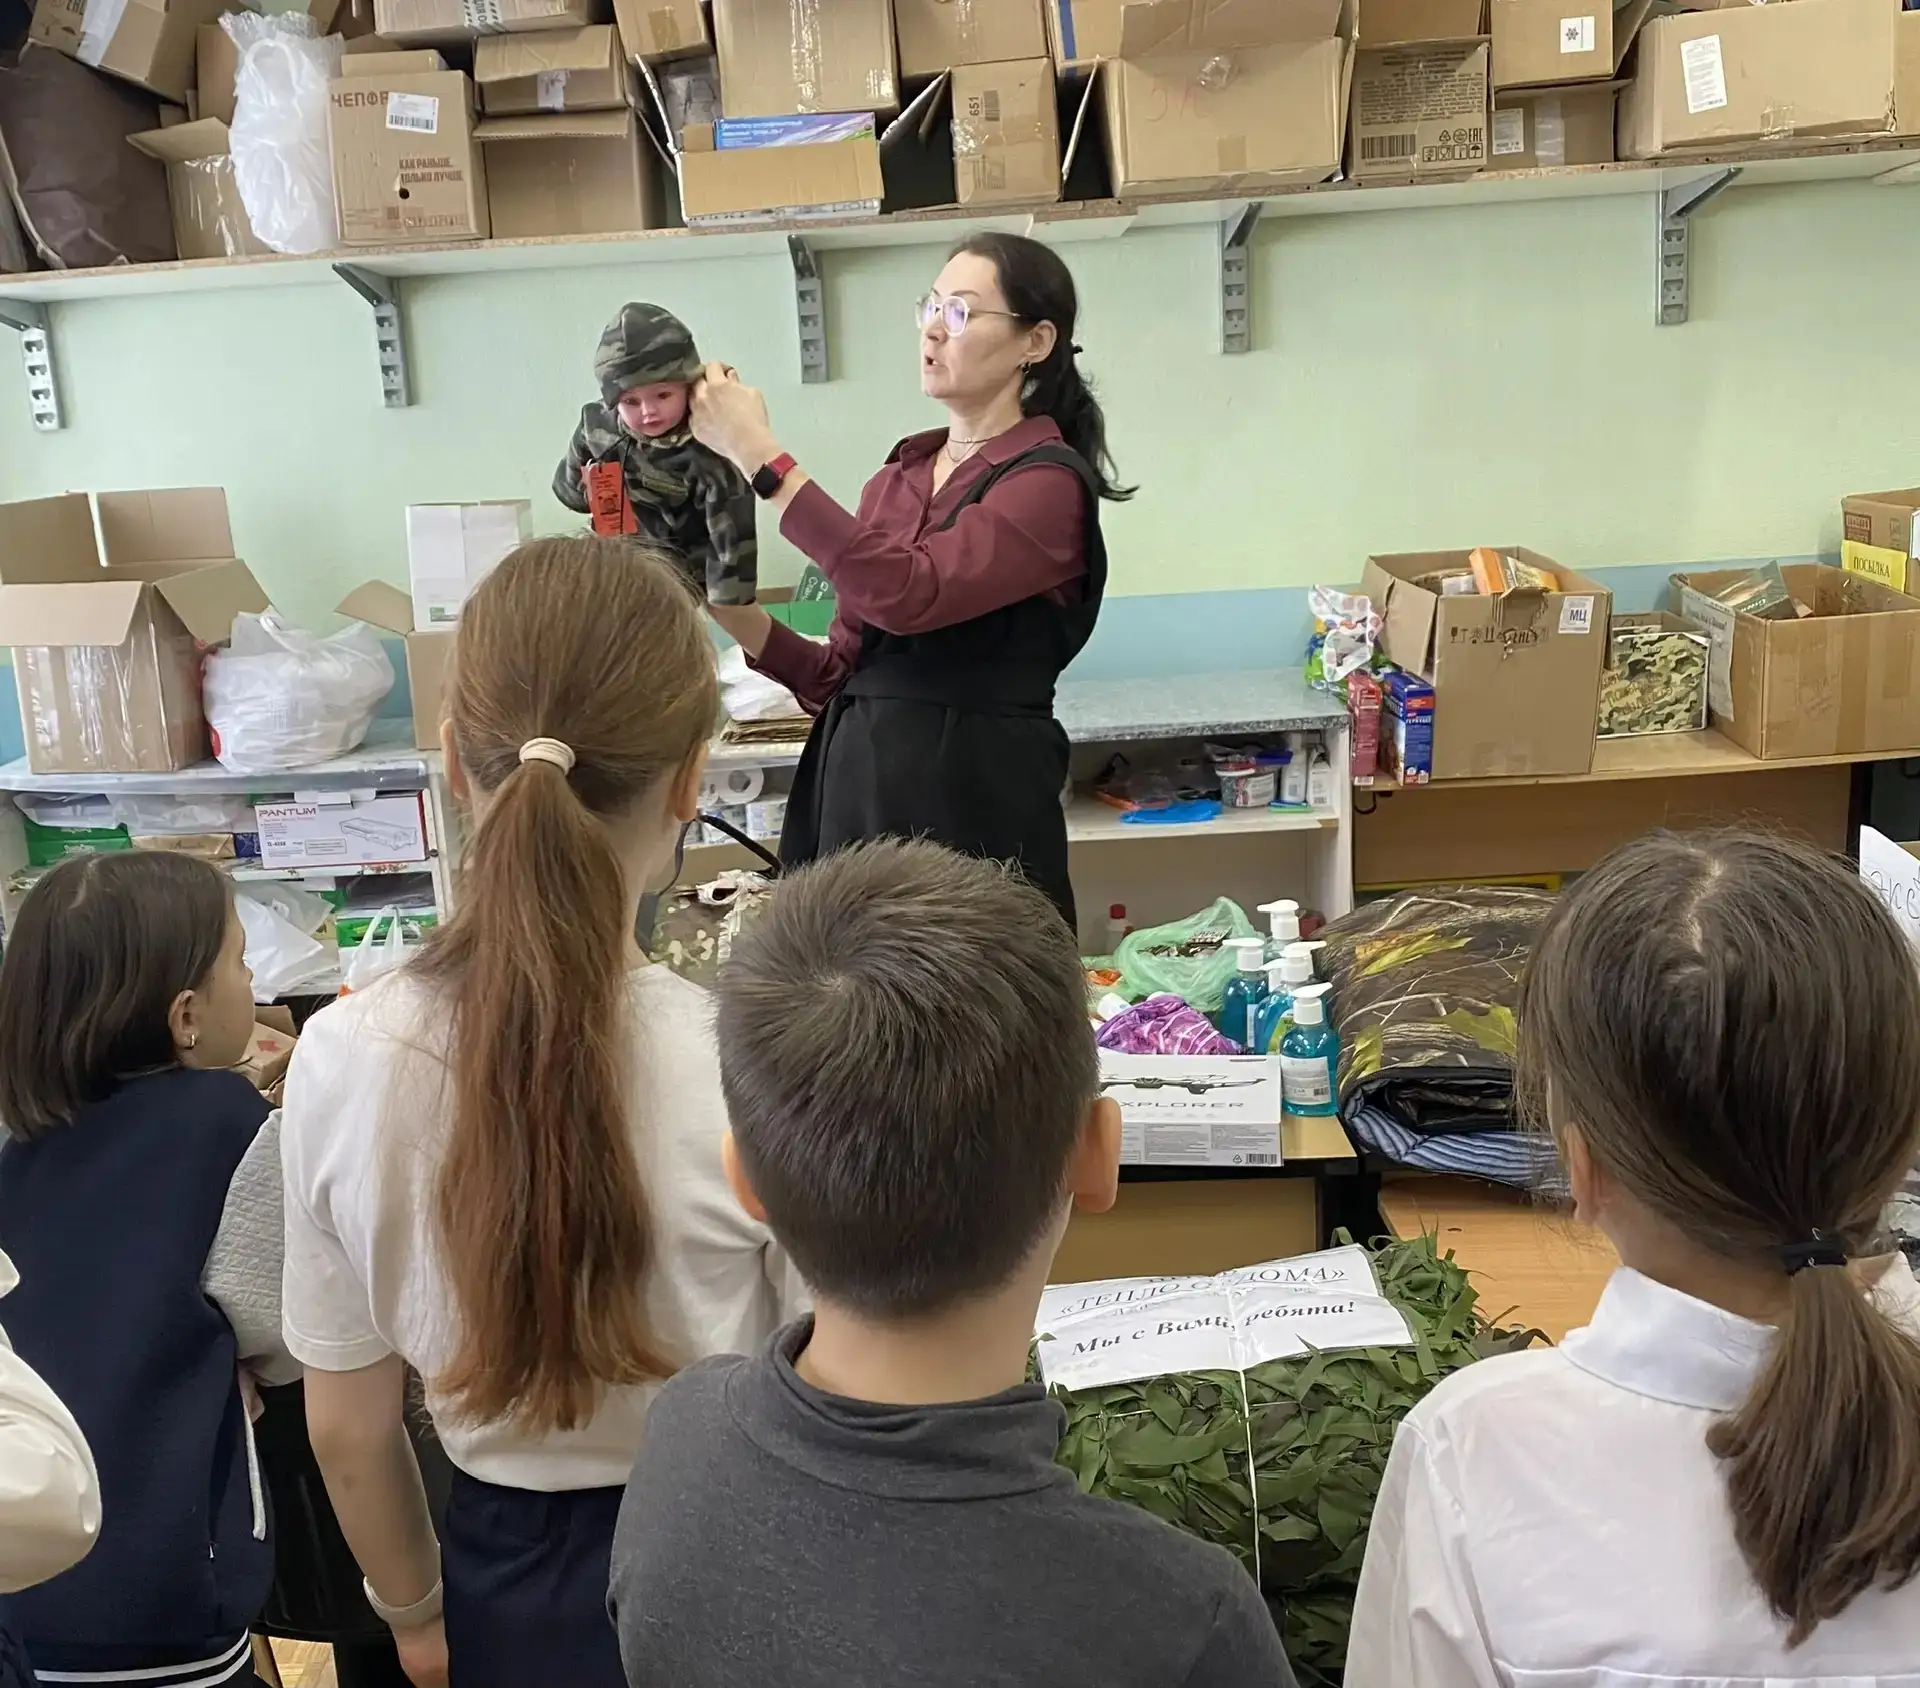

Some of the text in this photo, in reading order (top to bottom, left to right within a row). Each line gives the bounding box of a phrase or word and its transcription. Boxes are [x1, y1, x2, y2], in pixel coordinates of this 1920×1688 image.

[968, 96, 980, 116] 651
[1853, 556, 1891, 578] ПОСЫЛКА
[1569, 609, 1587, 623] МЦ
[259, 807, 316, 818] PANTUM
[1061, 1283, 1180, 1314] «ТЕПЛО
[1234, 1267, 1346, 1285] ДОМА»
[1072, 1335, 1121, 1356] Мы
[1132, 1329, 1146, 1340] с
[1244, 1301, 1355, 1327] ребята!
